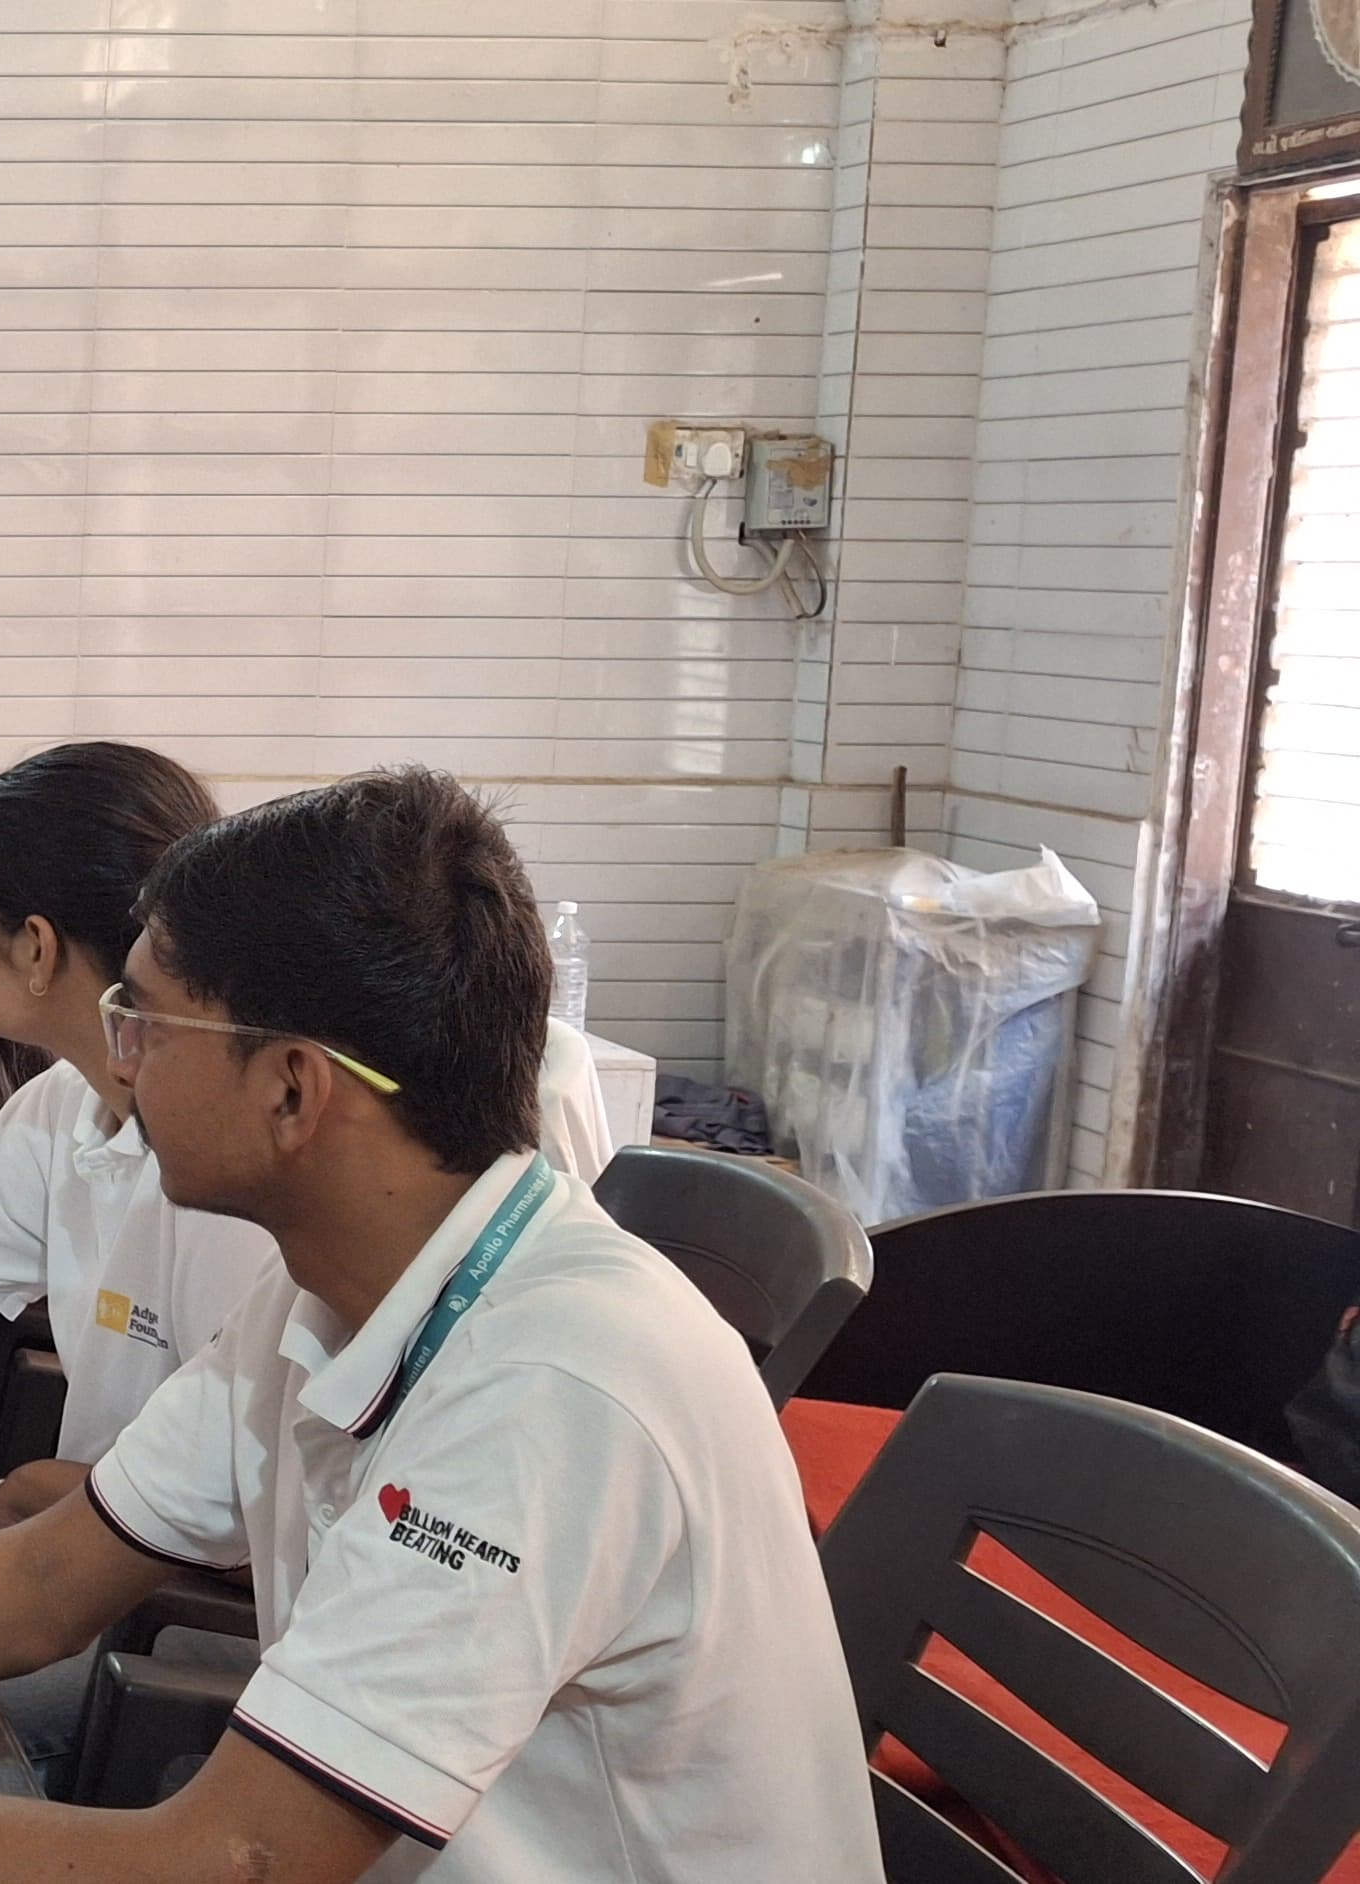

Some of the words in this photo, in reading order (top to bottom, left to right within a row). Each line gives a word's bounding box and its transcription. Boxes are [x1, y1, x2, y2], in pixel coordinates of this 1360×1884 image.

[468, 1238, 503, 1281] Apollo
[496, 1182, 546, 1237] Pharmacies
[389, 1521, 466, 1571] BEATING
[398, 1504, 454, 1540] BILLION
[453, 1527, 521, 1574] HEARTS
